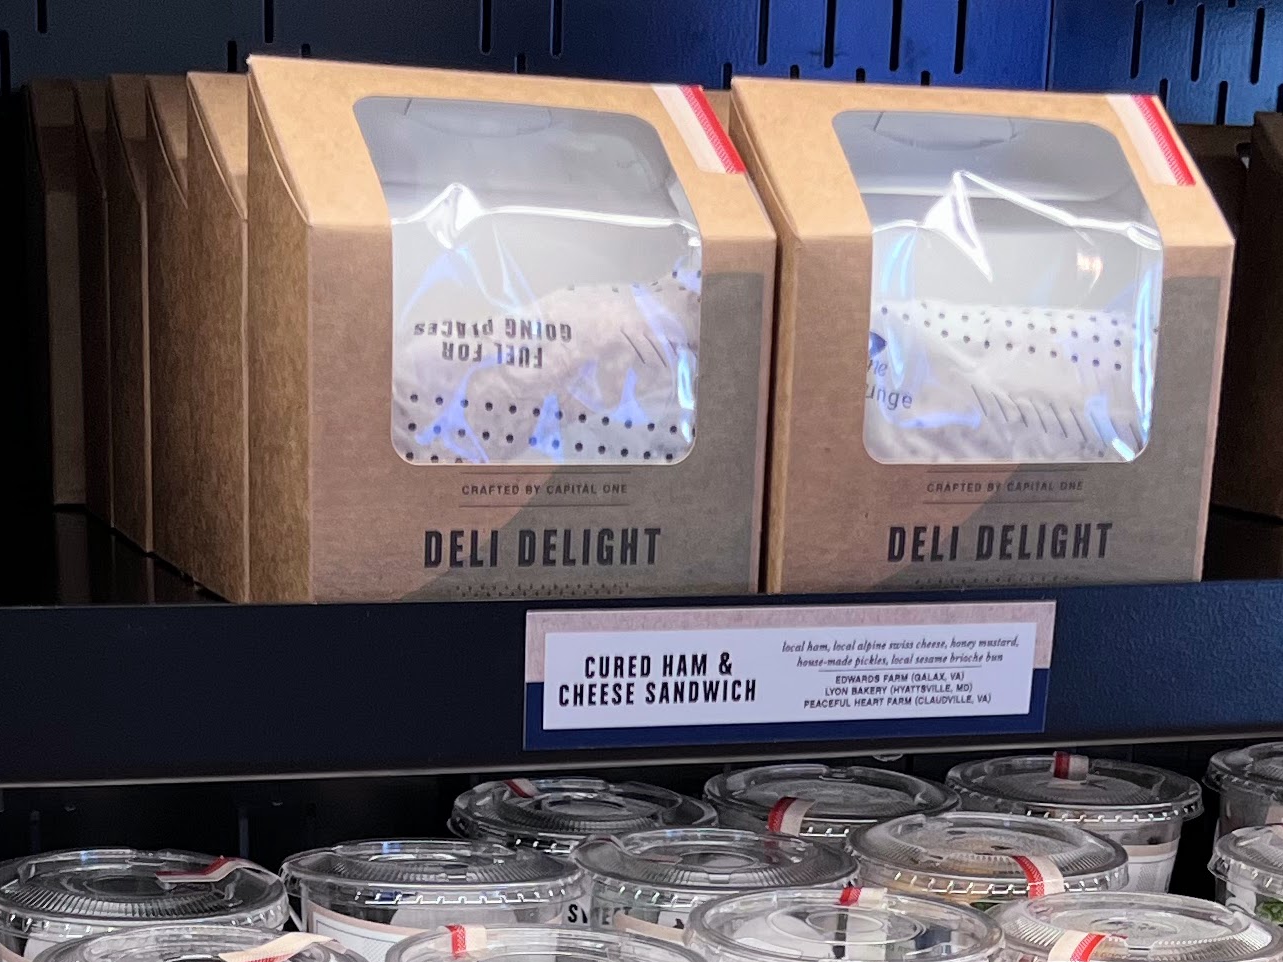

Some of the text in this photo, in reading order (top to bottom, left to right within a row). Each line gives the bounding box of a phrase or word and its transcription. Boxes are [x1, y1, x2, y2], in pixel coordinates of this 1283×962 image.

[413, 318, 572, 342] GOING PLACES
[441, 341, 543, 368] FUEL FOR
[461, 482, 628, 496] CRAFTED BY CAPITAL ONE
[927, 479, 1084, 494] CRAFTED BY CAPITAL ONE
[423, 527, 662, 568] DELI DELIGHT
[888, 522, 1113, 563] DELI DELIGHT
[782, 636, 1019, 653] local ham, local alpine swiss cheese, honey mustard,
[584, 651, 734, 679] CURED HAM &
[797, 652, 1003, 668] house-made pickles, local sesame brioche bun
[835, 674, 881, 684] EDWARDS
[883, 673, 908, 683] FARM
[950, 671, 965, 681] VA)
[558, 678, 758, 708] CHEESE SANDWICH
[825, 683, 973, 696] LYON BAKERY (HYATTSVILLE, MD)
[804, 693, 992, 709] PEACEFUL HEART FARM (CLAUDVILLE, VA)
